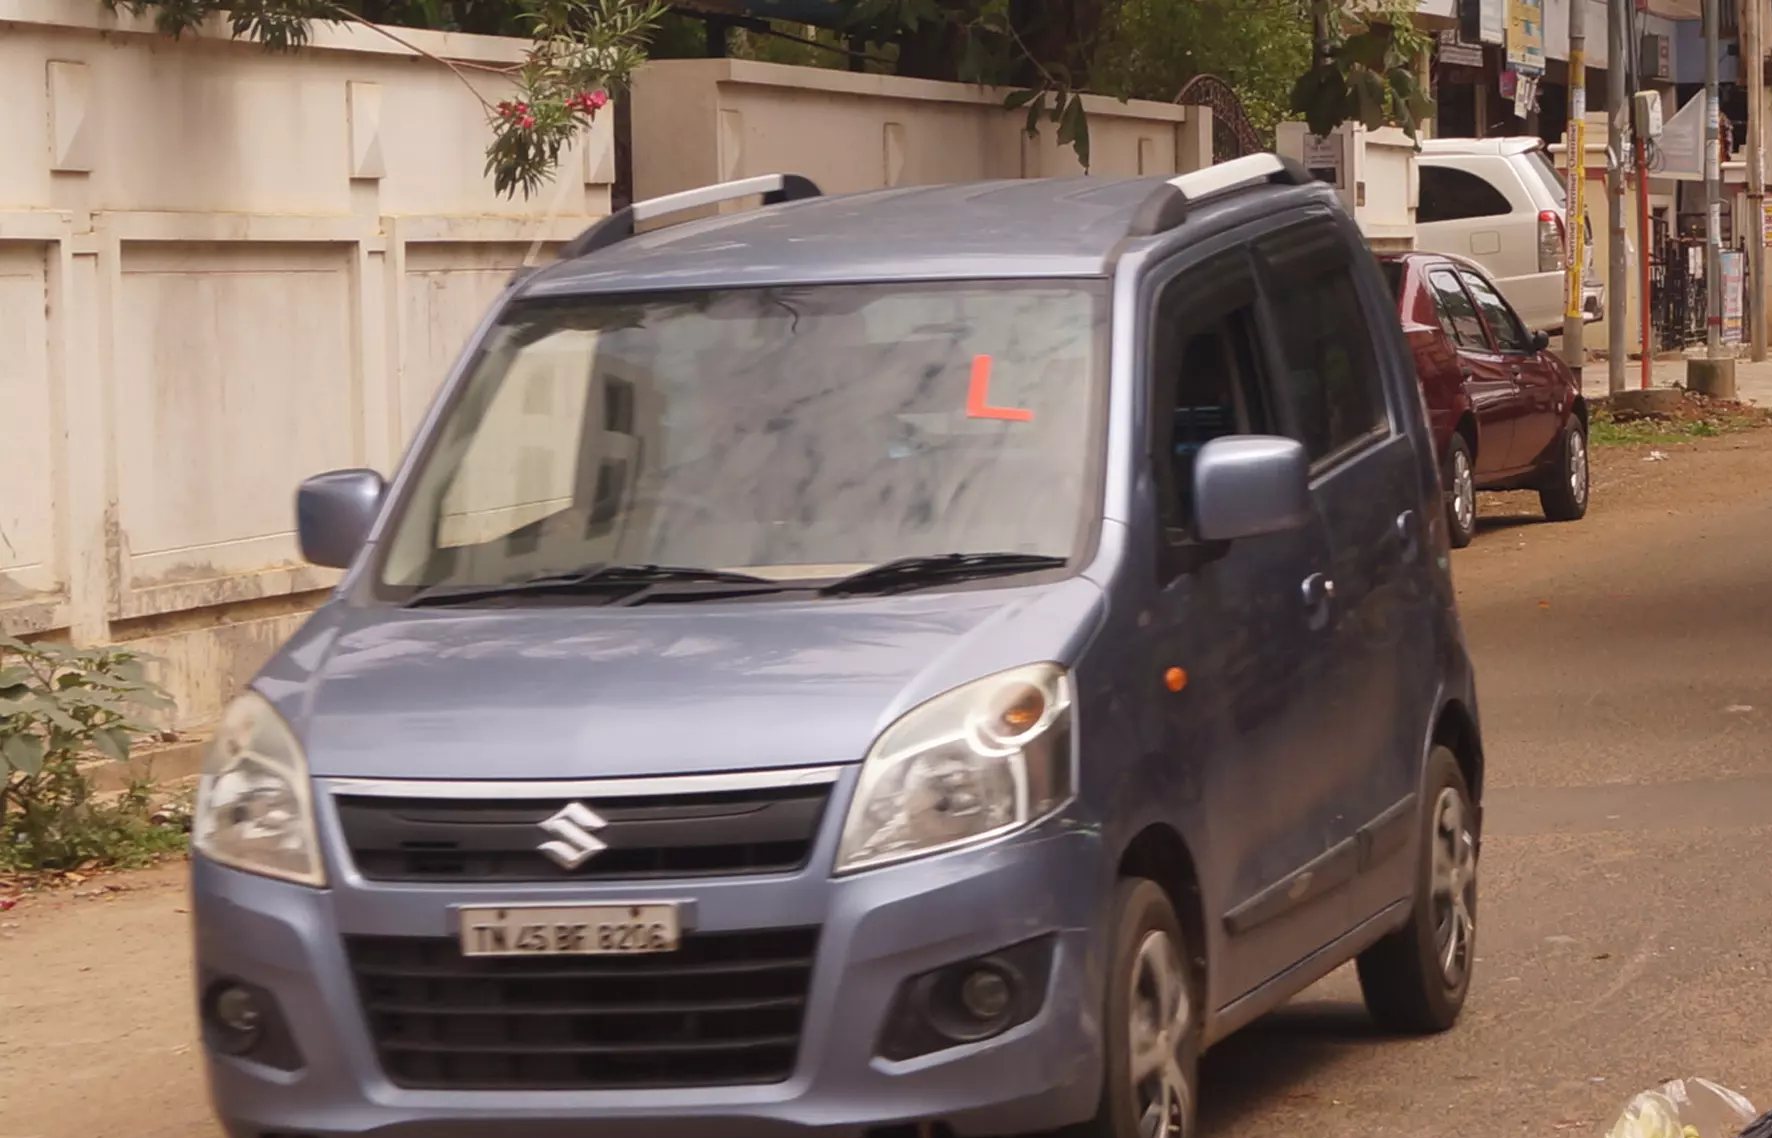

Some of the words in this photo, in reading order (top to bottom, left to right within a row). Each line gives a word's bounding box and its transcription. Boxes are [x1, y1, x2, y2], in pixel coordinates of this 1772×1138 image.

[966, 354, 1035, 422] L
[471, 925, 508, 952] TN
[515, 924, 549, 951] 45
